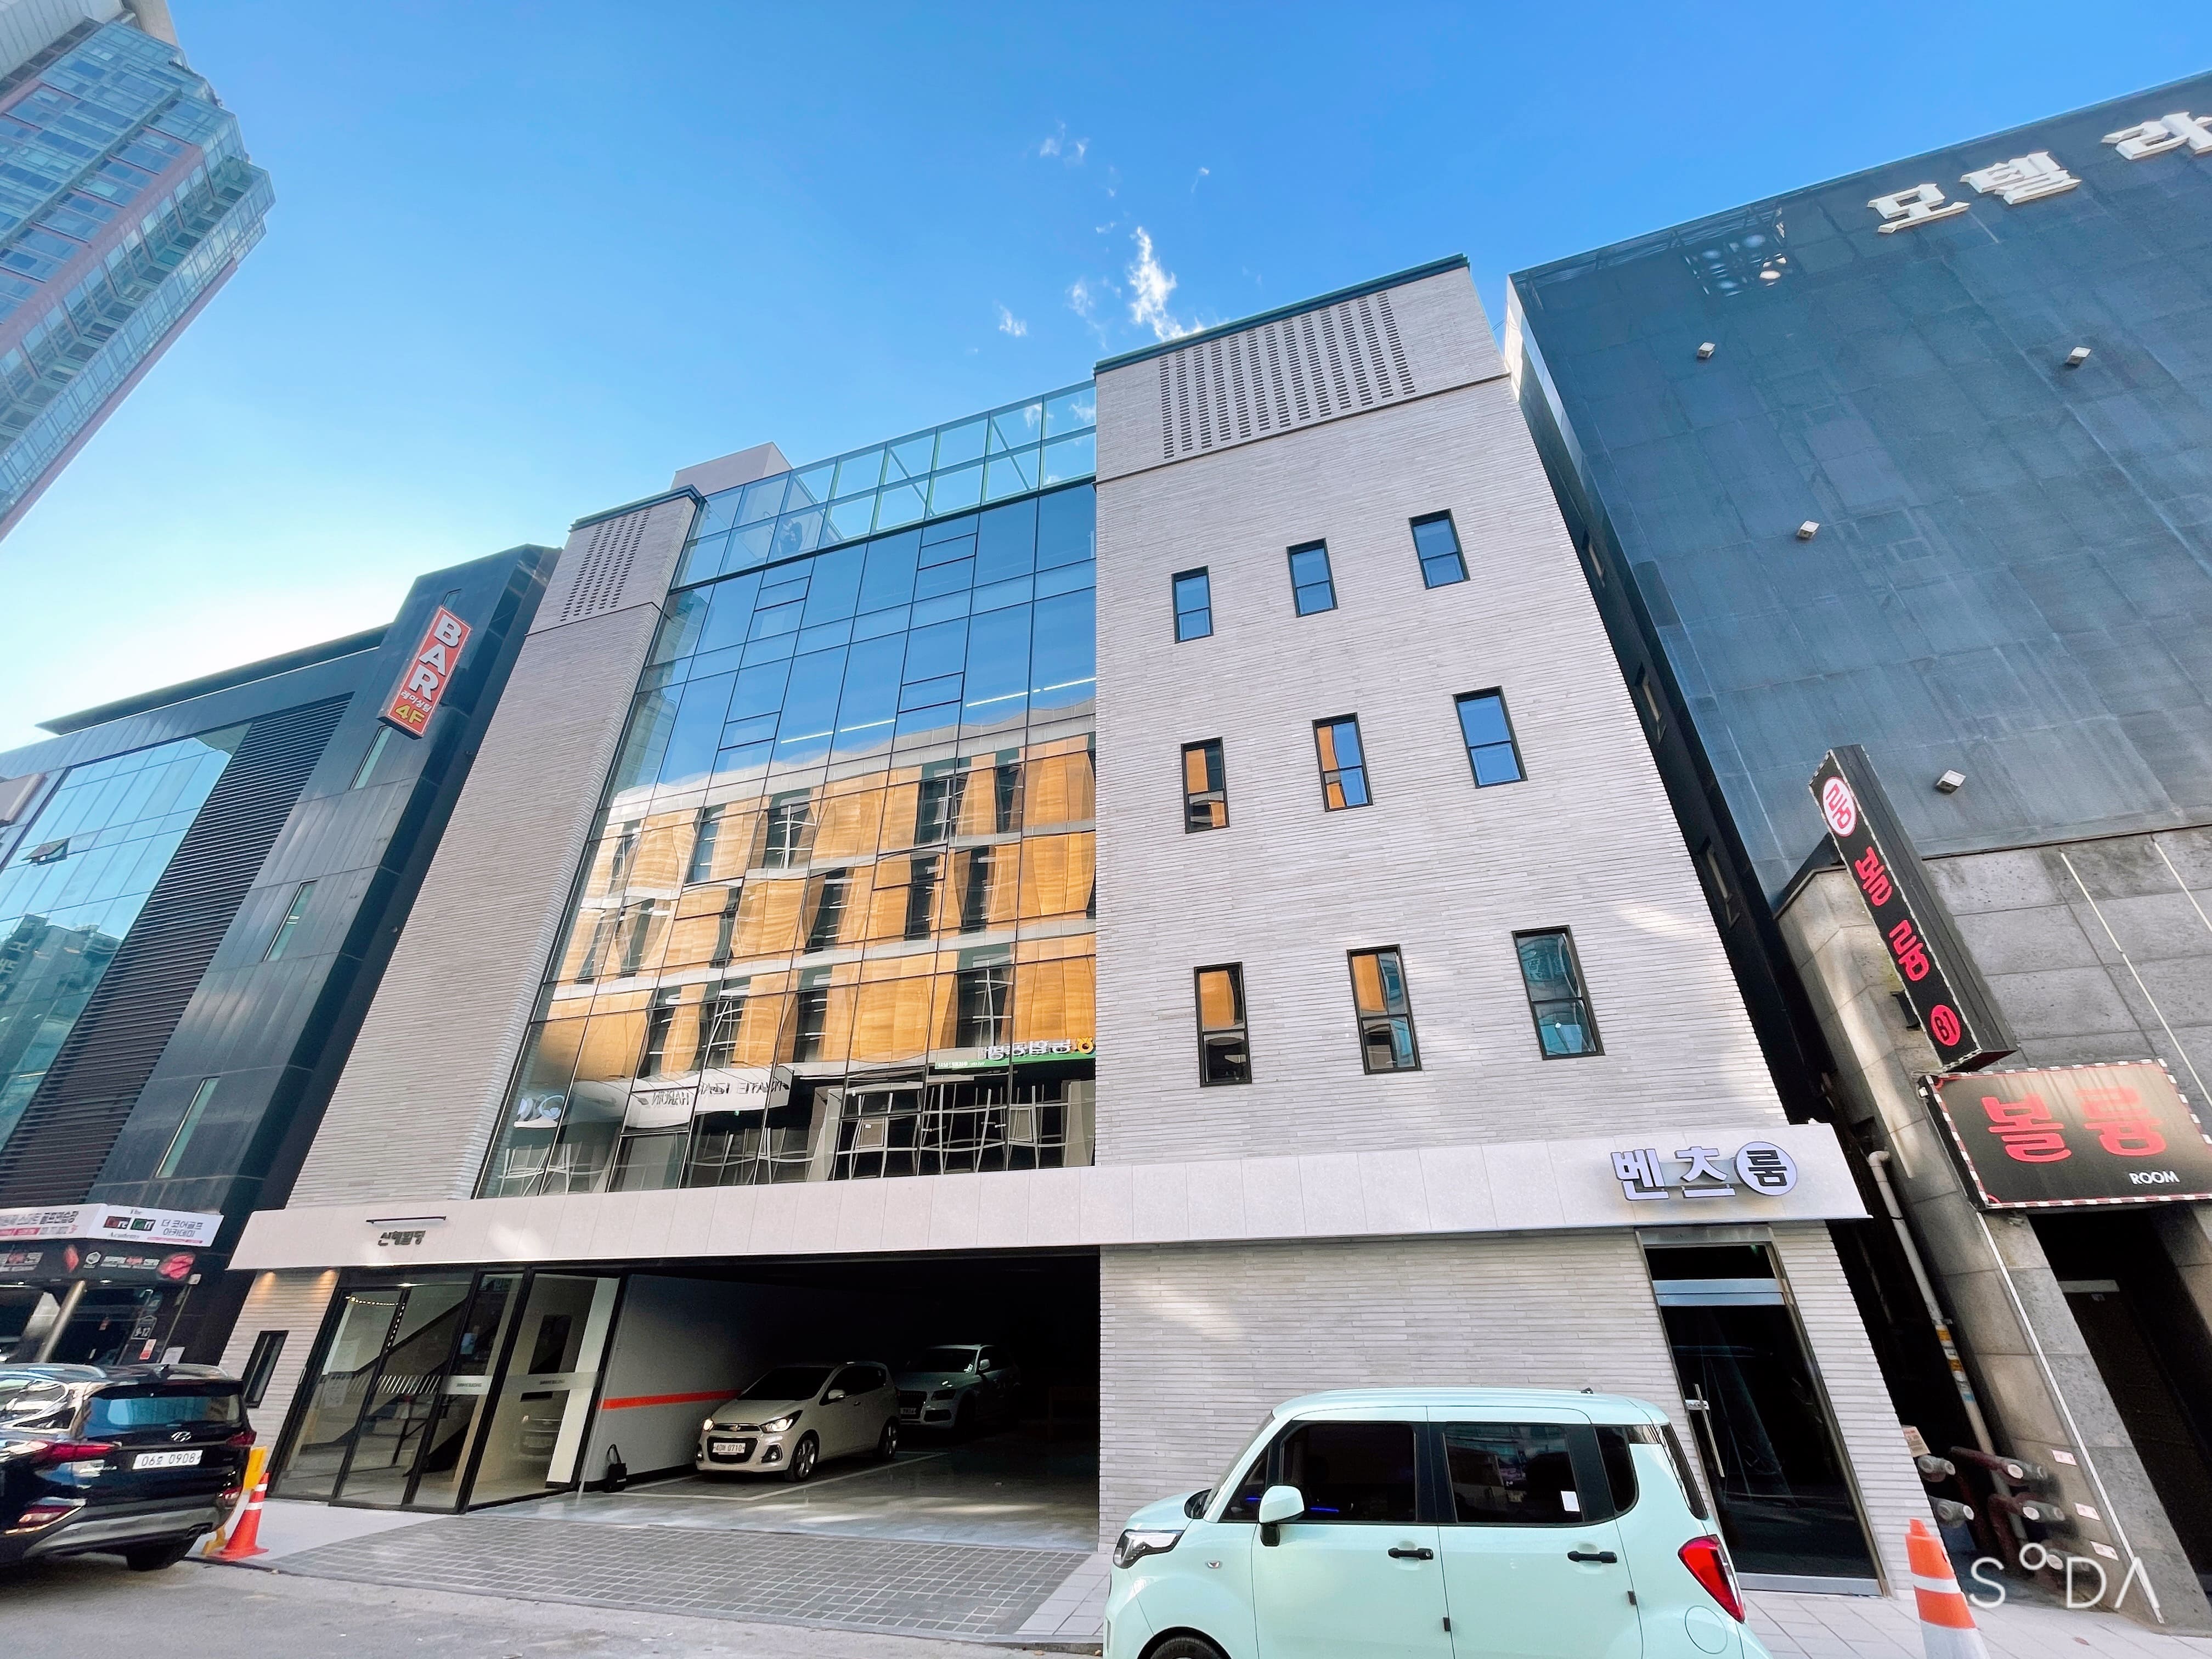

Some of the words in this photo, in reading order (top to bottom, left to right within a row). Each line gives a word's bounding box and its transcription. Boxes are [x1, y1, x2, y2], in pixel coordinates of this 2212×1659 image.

[1866, 151, 2082, 234] 모텔
[409, 614, 462, 702] BAR
[395, 704, 426, 724] 4F
[1933, 1011, 1957, 1042] B1
[2129, 1170, 2181, 1186] ROOM
[162, 1228, 195, 1238] 아카데미
[171, 1220, 204, 1230] 코어골프
[168, 1452, 196, 1464] 0908
